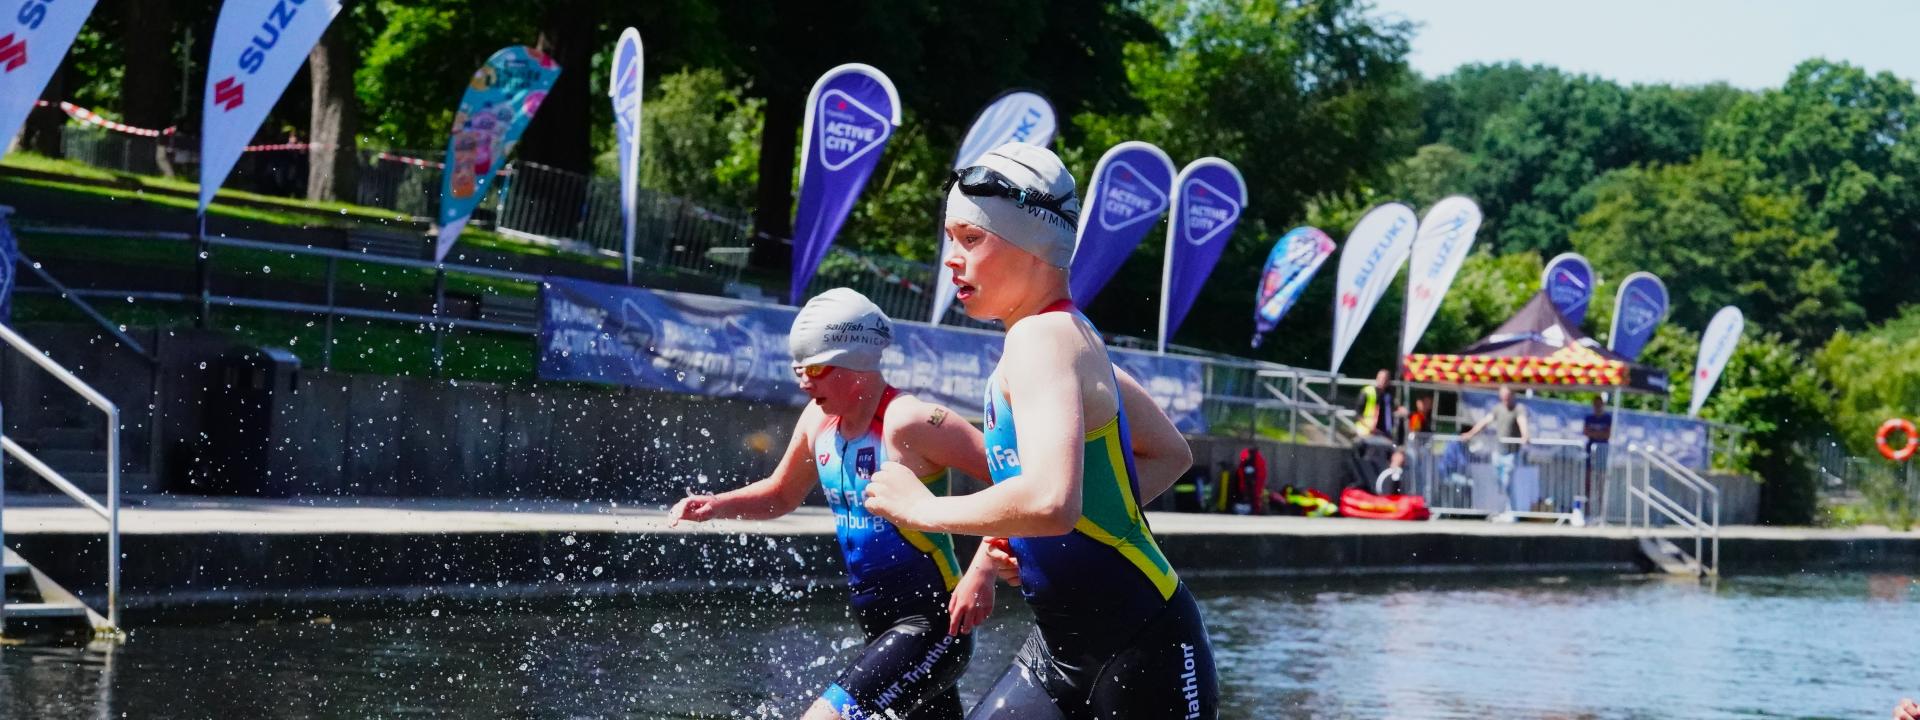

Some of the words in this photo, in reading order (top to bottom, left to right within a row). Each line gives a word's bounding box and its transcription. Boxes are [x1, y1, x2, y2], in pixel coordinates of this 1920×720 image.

[18, 0, 54, 29] S
[238, 0, 305, 74] SUZ
[826, 120, 876, 142] ACTIVE
[826, 134, 857, 153] CITY
[1105, 199, 1135, 218] CITY
[1108, 187, 1151, 211] ACTIVE
[1190, 204, 1229, 222] ACTIVE
[1190, 216, 1215, 230] CITY
[1354, 215, 1407, 289] SUZUKI
[1428, 209, 1470, 279] SUZUKI
[824, 321, 864, 334] sailfish
[833, 511, 885, 532] mburg
[1181, 645, 1200, 720] iathlon
